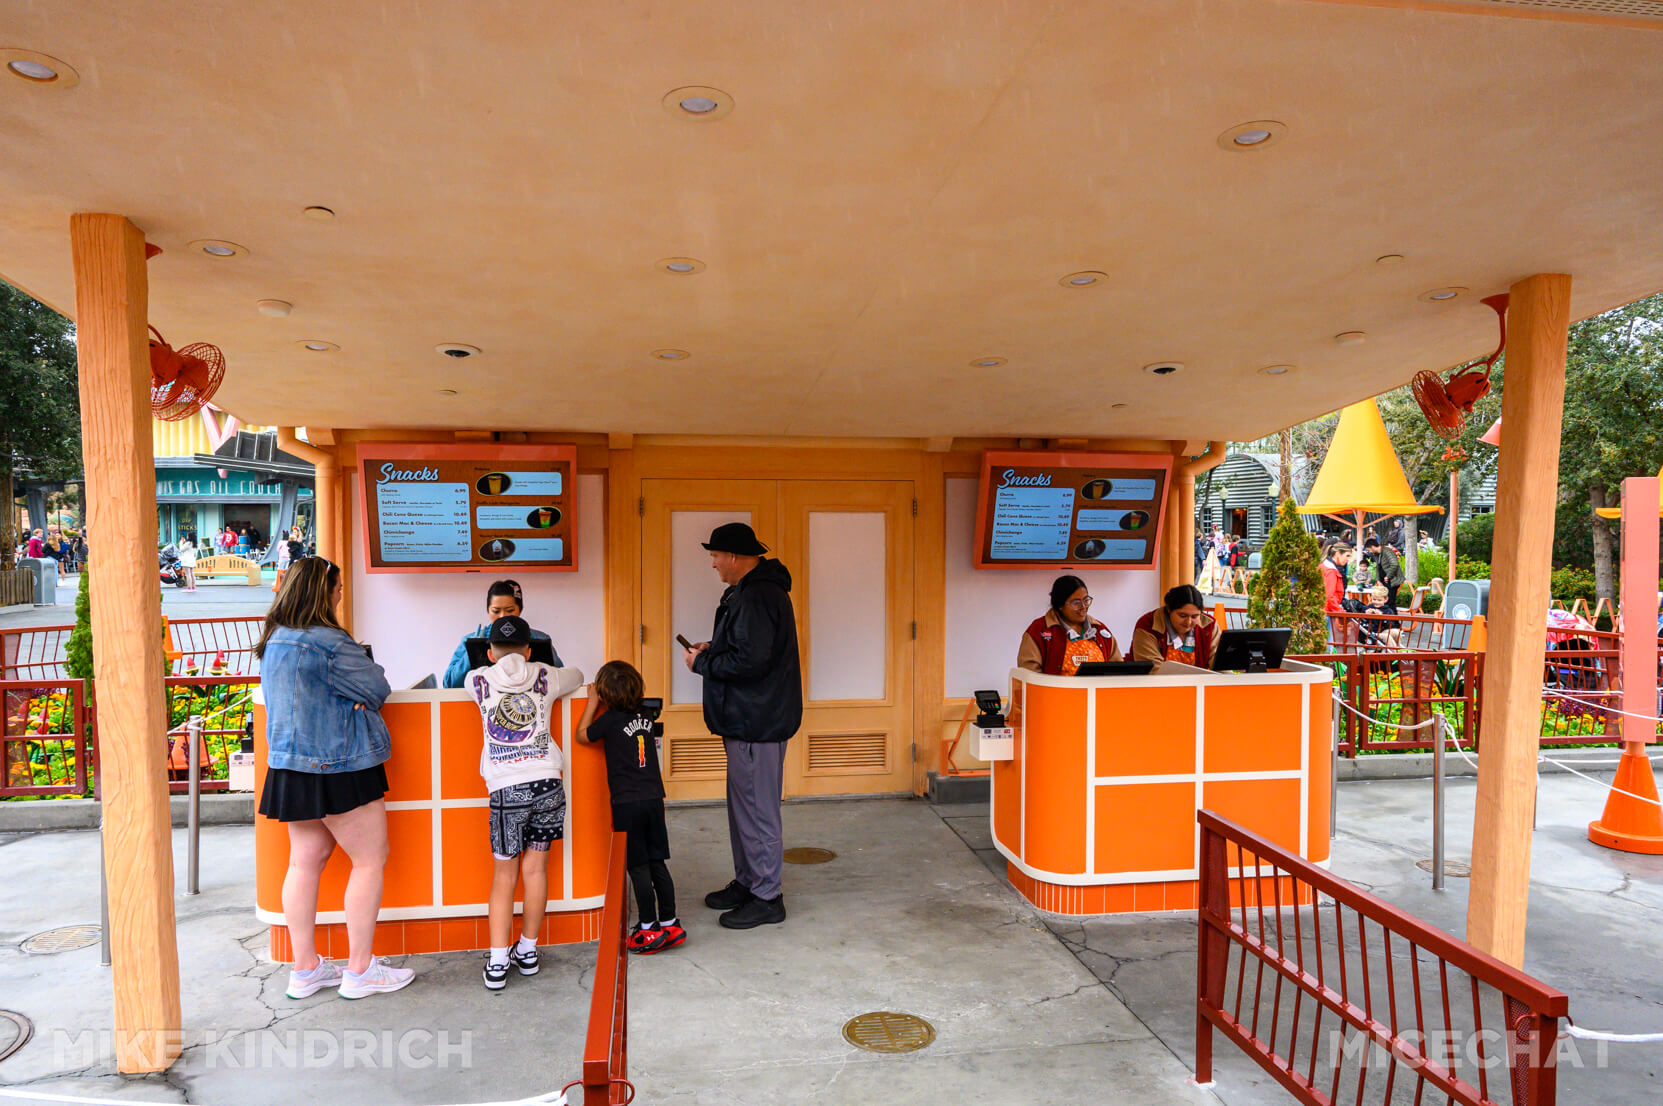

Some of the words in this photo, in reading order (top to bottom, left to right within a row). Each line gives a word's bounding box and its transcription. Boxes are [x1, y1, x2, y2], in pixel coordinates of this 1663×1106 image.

[376, 462, 439, 485] Snacks
[997, 469, 1052, 489] Snacks
[179, 480, 200, 494] GAS
[210, 480, 229, 494] OIL
[623, 718, 653, 737] BOOKER
[637, 735, 646, 768] 1
